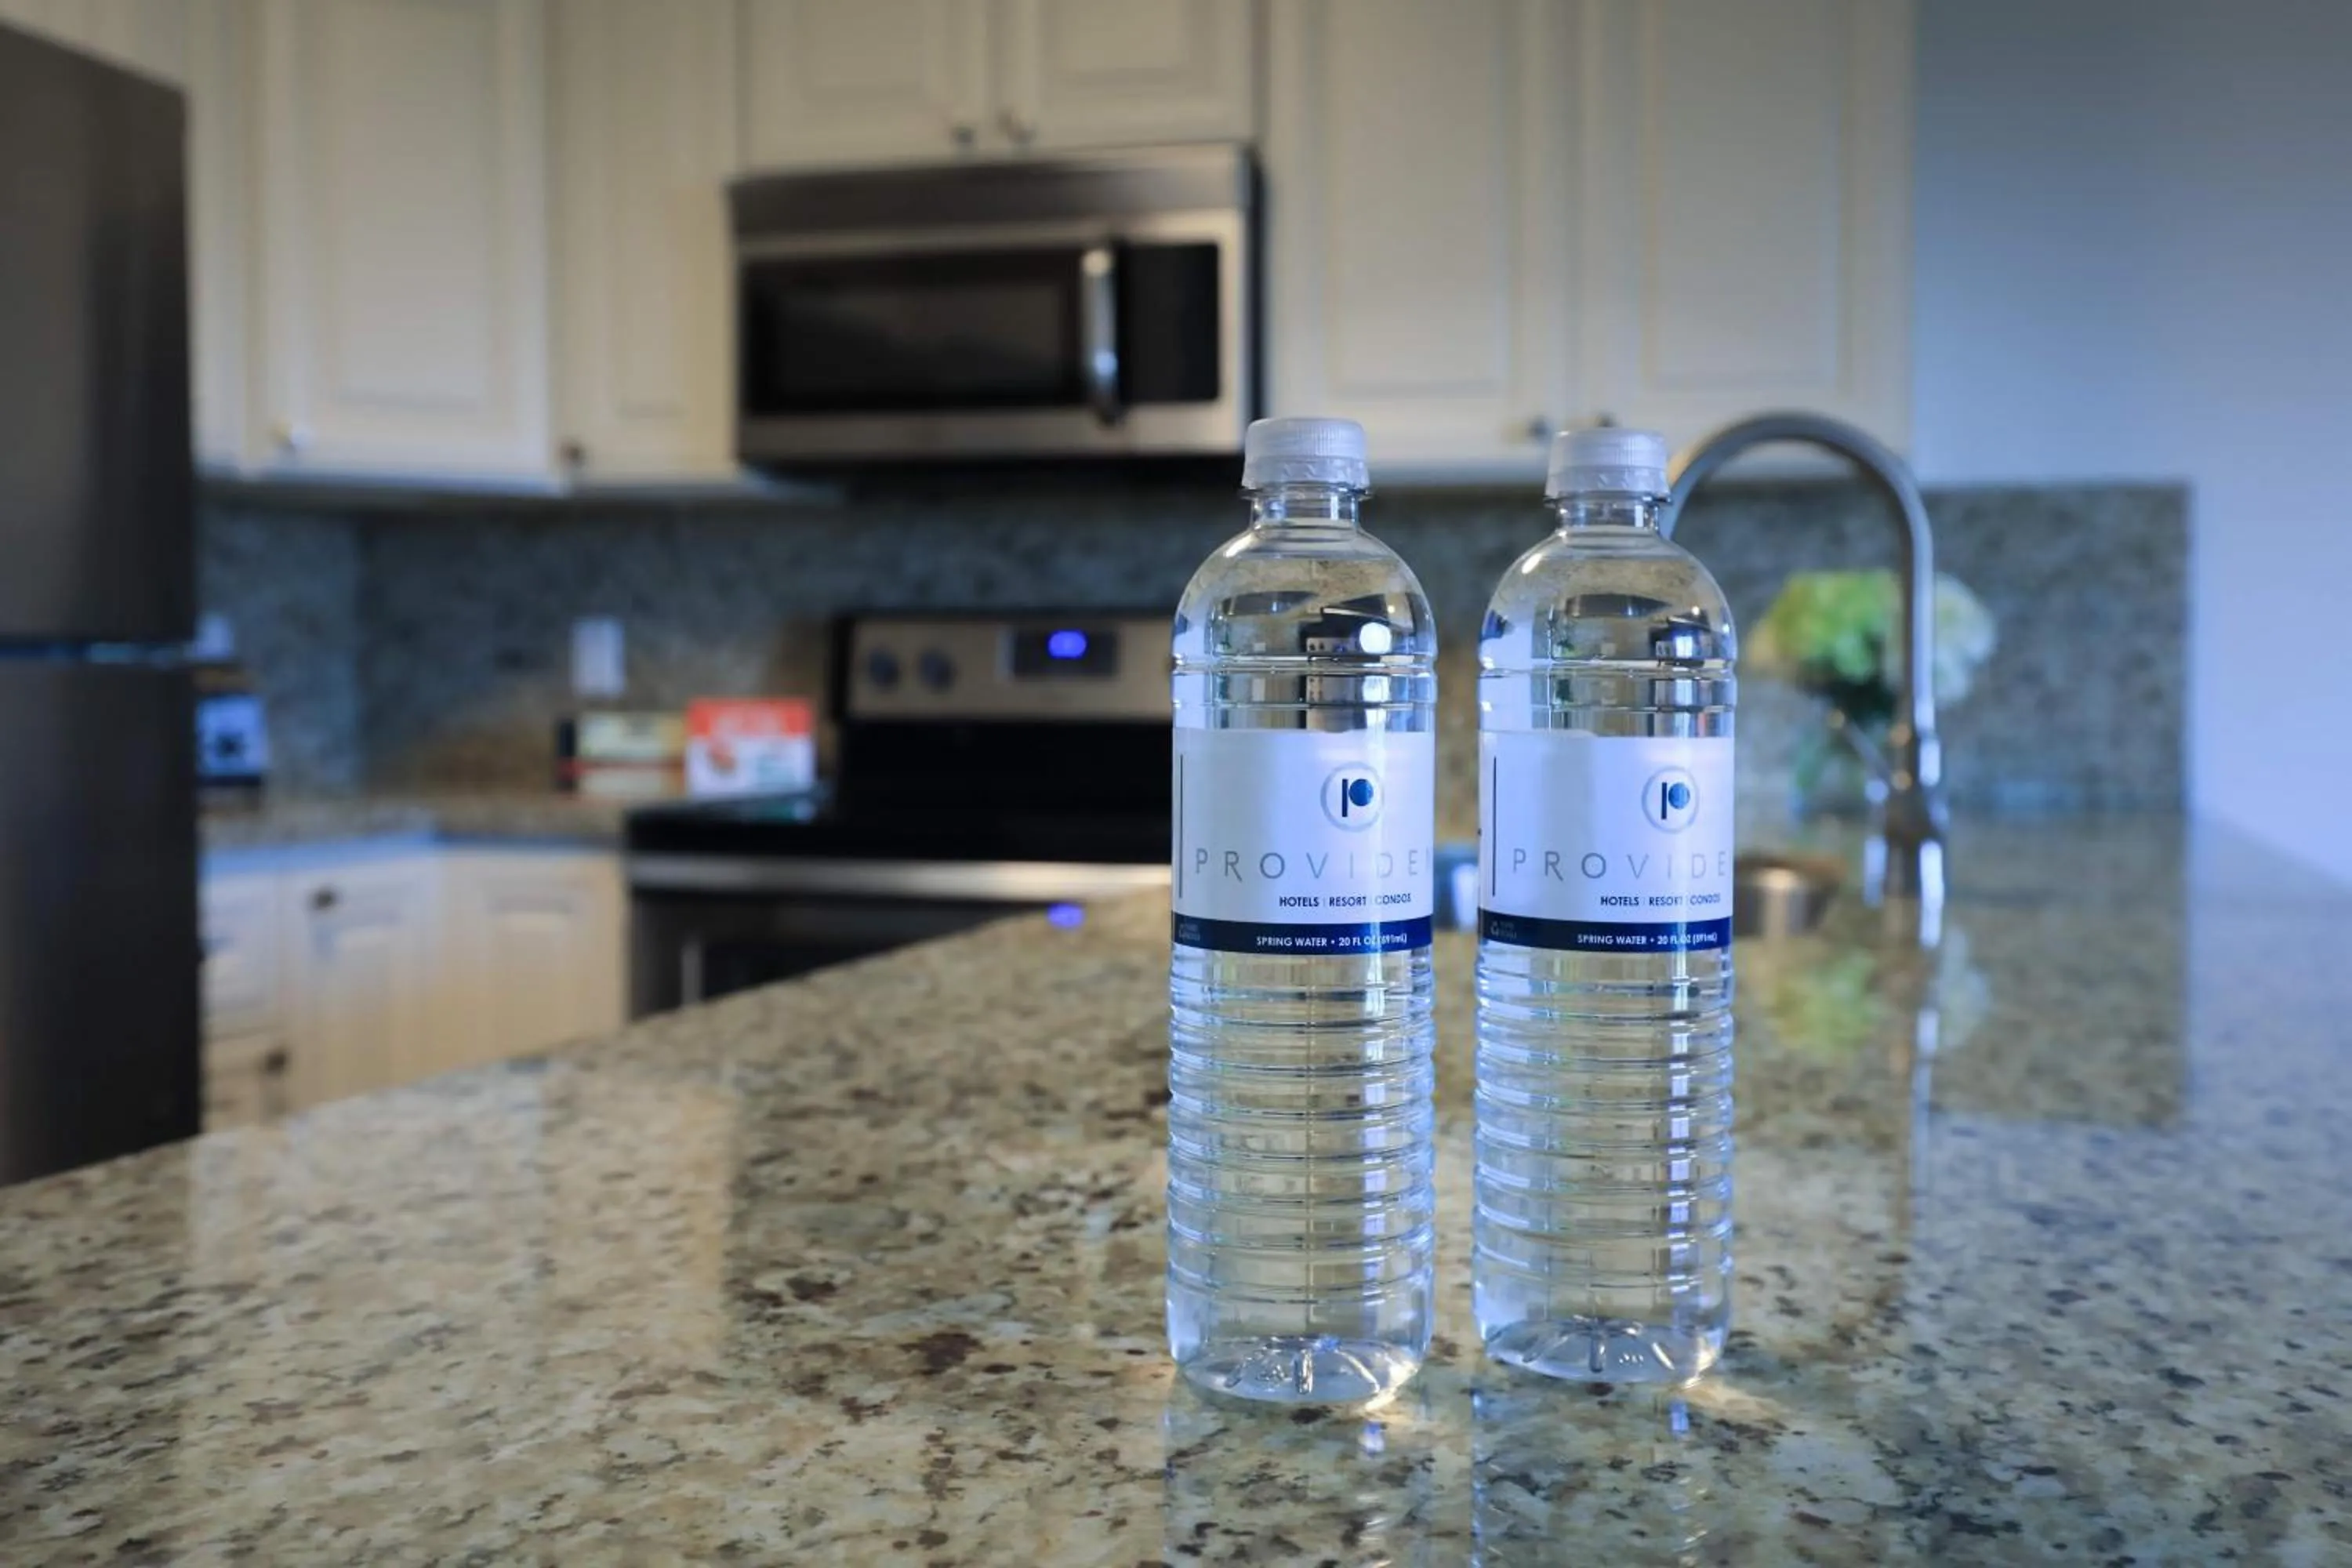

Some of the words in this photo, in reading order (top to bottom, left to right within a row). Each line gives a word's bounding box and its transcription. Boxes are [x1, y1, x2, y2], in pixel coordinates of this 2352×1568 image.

[1196, 848, 1429, 881] PROVIDE
[1513, 848, 1726, 881] PROVIDE
[1279, 895, 1319, 907] HOTELS
[1329, 895, 1367, 907] RESORT
[1374, 893, 1411, 906] CONDOS
[1600, 896, 1639, 906] HOTELS
[1649, 895, 1683, 906] RESORT
[1256, 935, 1293, 946] SPRING
[1294, 937, 1327, 946] WATER
[1338, 937, 1349, 946] 20
[1352, 937, 1361, 946] FL
[1577, 935, 1613, 945] SPRING
[1615, 935, 1646, 945] WATER
[1657, 935, 1669, 945] 20
